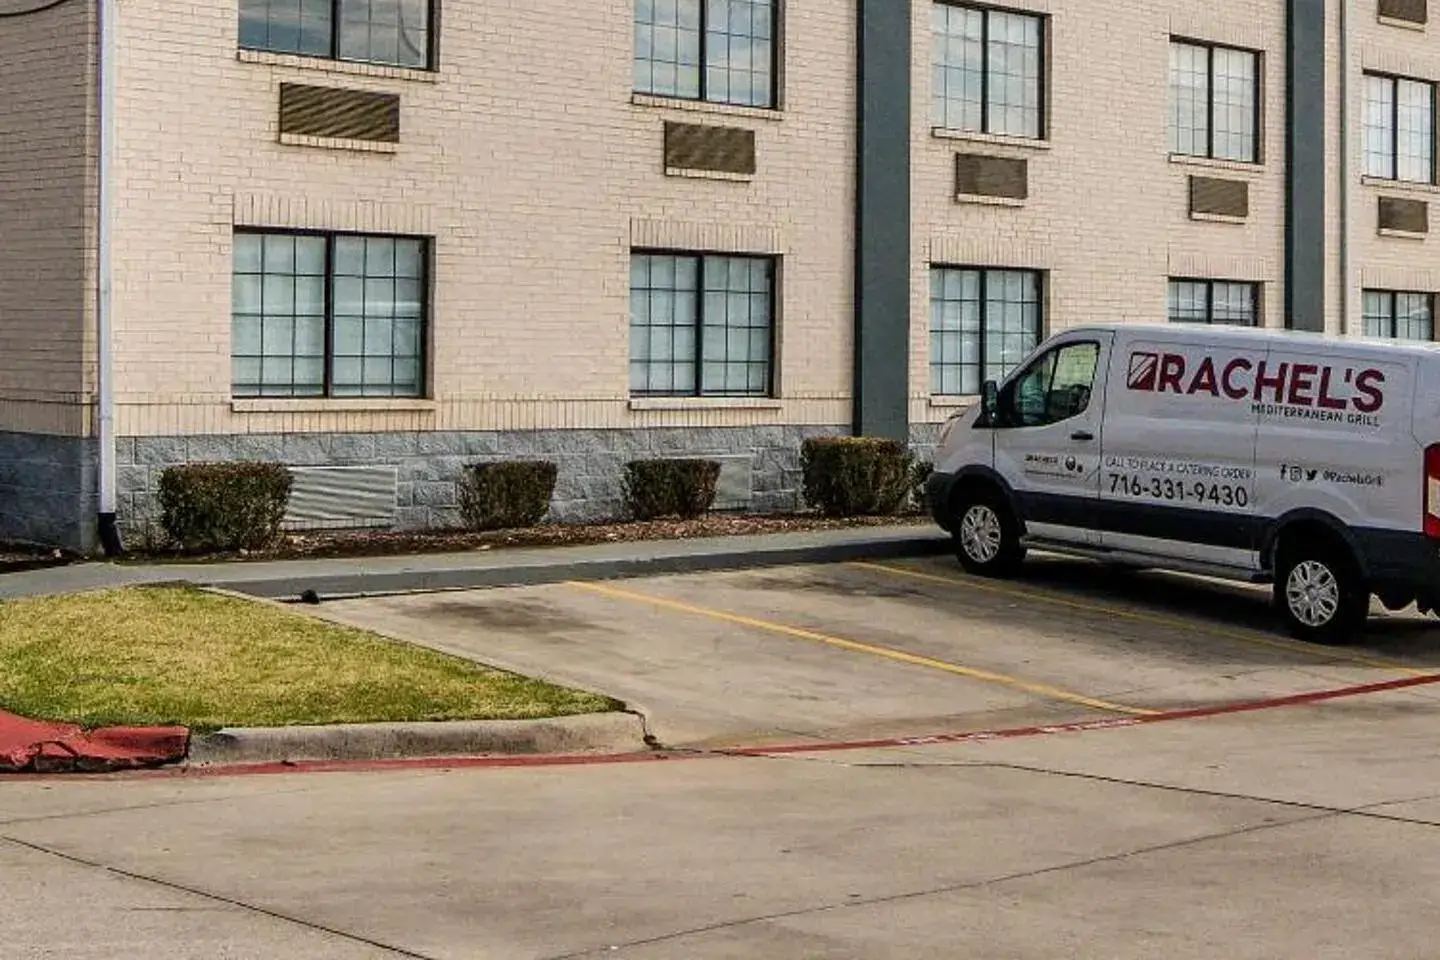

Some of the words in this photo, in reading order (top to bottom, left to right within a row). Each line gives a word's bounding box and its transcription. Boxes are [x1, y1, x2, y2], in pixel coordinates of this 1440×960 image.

[1157, 353, 1386, 413] RACHEL'S
[1251, 403, 1342, 422] MEDITERRANEAN
[1347, 414, 1380, 427] GRILL
[1109, 473, 1249, 507] 716-331-9430
